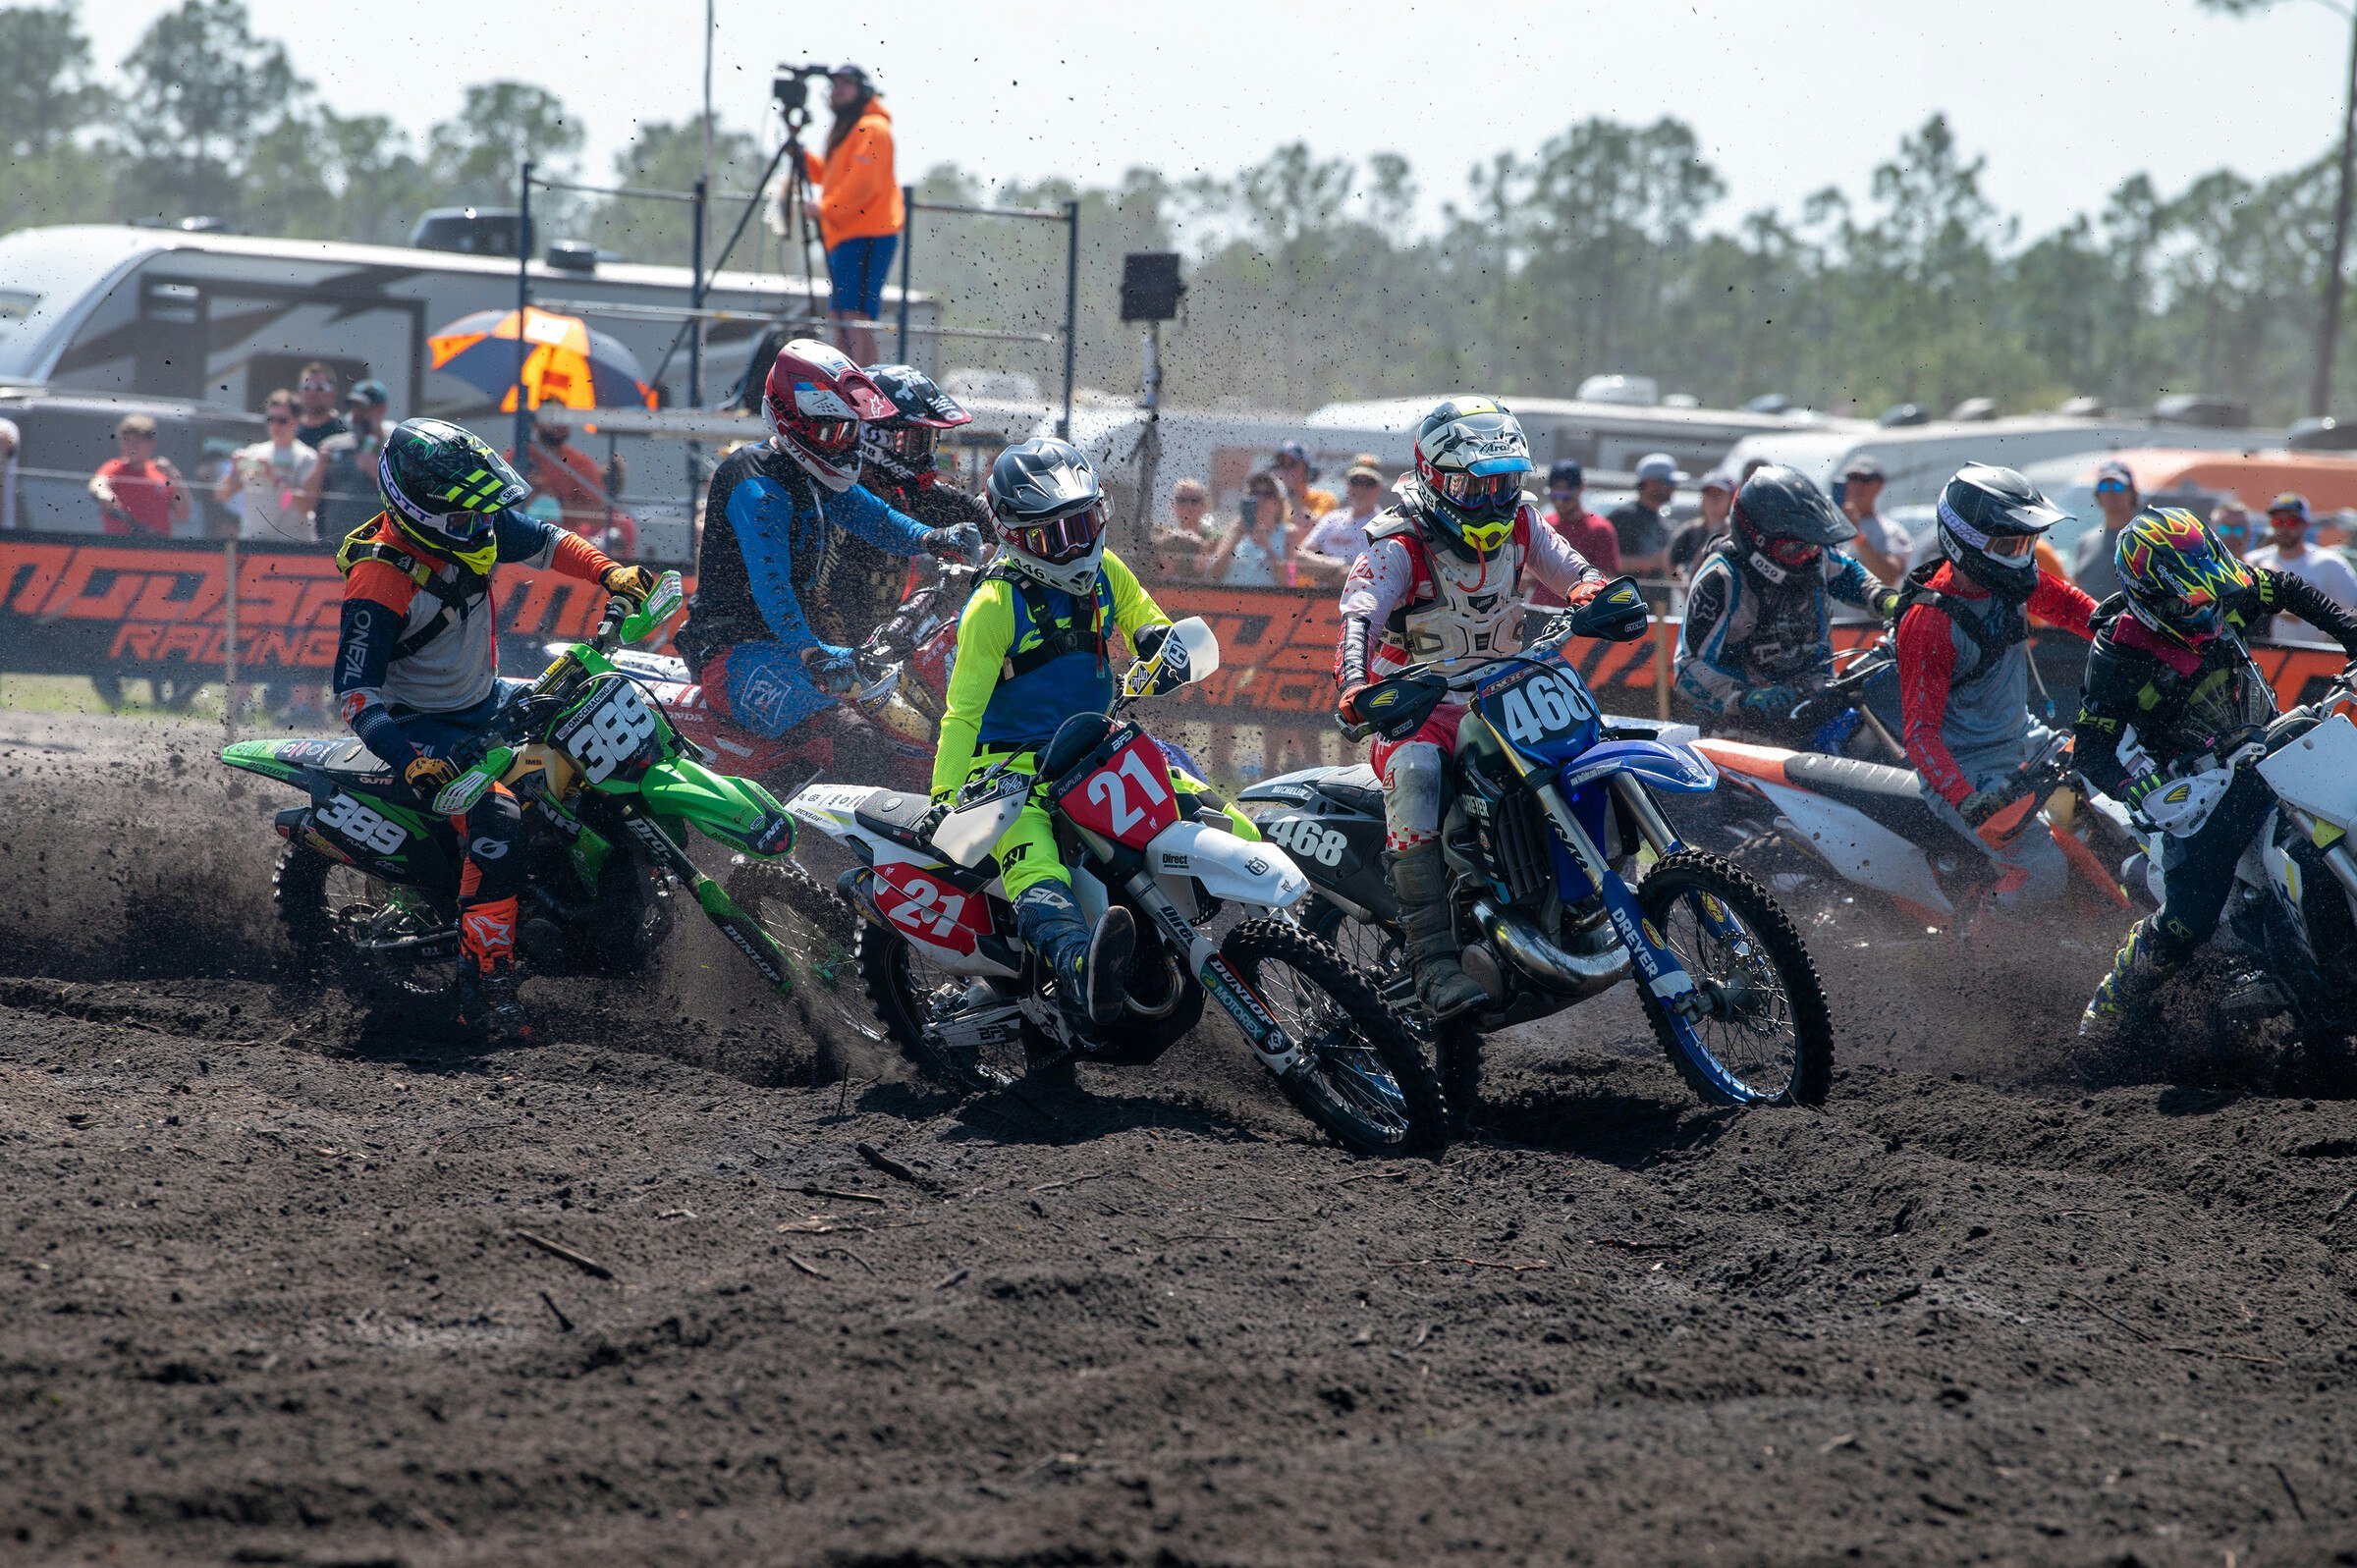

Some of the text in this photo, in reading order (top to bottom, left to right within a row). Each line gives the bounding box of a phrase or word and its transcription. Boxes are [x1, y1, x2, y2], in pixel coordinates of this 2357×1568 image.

[569, 676, 621, 729] GNCCRACING.COM
[657, 710, 703, 723] ONDA
[1502, 667, 1595, 745] 468
[568, 682, 656, 784] 389
[247, 761, 288, 778] DUNLOP
[1058, 772, 1083, 796] DUPUIS
[1087, 748, 1168, 838] 21
[1271, 785, 1309, 798] MICHELIN
[315, 792, 409, 856] 389
[794, 807, 823, 822] DUNLOP
[1267, 815, 1348, 867] 468
[1162, 852, 1188, 865] Direct
[889, 878, 965, 938] 21
[722, 924, 781, 982] DUNLOP
[1612, 906, 1659, 980] DREYER
[1209, 958, 1275, 1027] DUNLOP
[1215, 986, 1264, 1039] MOTOREX
